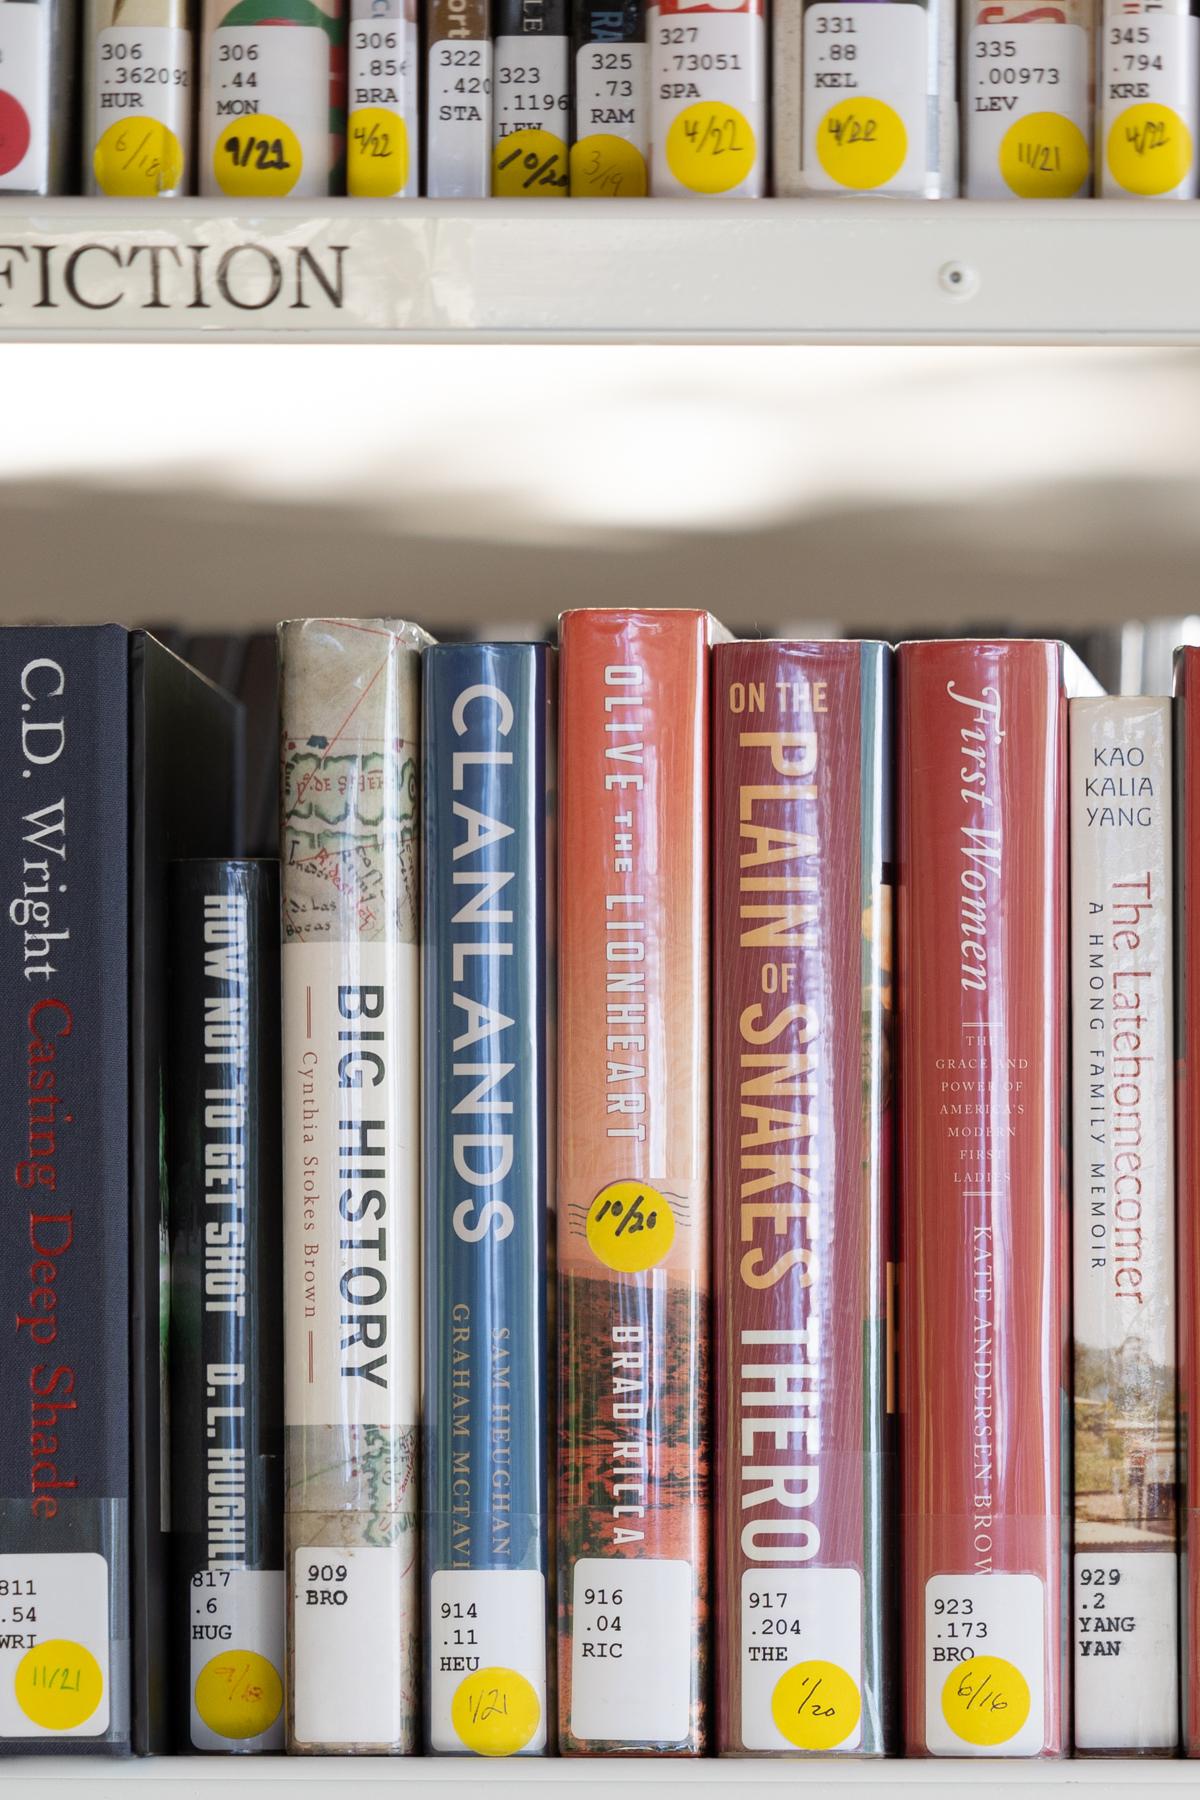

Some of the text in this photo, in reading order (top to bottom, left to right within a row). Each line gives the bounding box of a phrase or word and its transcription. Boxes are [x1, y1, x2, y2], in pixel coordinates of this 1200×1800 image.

[816, 17, 856, 33] 331
[660, 27, 698, 45] 327
[100, 43, 141, 61] 306
[219, 44, 258, 61] 306
[819, 44, 856, 61] .88
[976, 41, 1016, 58] 335
[662, 54, 741, 73] .73051
[222, 72, 257, 88] .44
[815, 73, 857, 88] KEL
[979, 68, 1060, 85] .00973
[660, 83, 700, 99] SPA
[99, 93, 143, 108] HUR
[217, 100, 259, 115] MON
[975, 96, 1018, 112] LEV
[684, 118, 743, 156] 4/22
[1018, 142, 1061, 172] 11/21
[729, 681, 828, 713] ON THE
[1094, 747, 1144, 766] KAO
[1085, 777, 1153, 796] KALIA
[9, 657, 70, 982] C.D. Wright
[1087, 808, 1152, 826] YANG
[740, 732, 819, 948] PLAIN
[947, 680, 1001, 991] First Women
[604, 664, 646, 1142] OLIVE THE LIONHEART
[451, 684, 514, 1242] CLANLANDS
[761, 963, 794, 994] OF
[1111, 872, 1153, 1304] The Latehomecomer
[740, 1003, 821, 1290] SNAKES
[301, 1052, 320, 1319] Cynthia Stokes Brown
[338, 985, 388, 1390] BIG HISTORY
[15, 998, 78, 1521] Casting Deep Shade
[613, 1326, 644, 1545] BRAD RICCA
[308, 1565, 347, 1581] 909
[306, 1590, 348, 1605] BRO
[585, 1589, 622, 1605] 916
[750, 1593, 787, 1608] 917
[441, 1603, 477, 1618] 914
[935, 1599, 973, 1615] 923
[587, 1616, 621, 1631] .04
[752, 1619, 800, 1635] .204
[937, 1622, 987, 1638] .173
[444, 1629, 477, 1645] .11
[582, 1643, 622, 1658] RIC
[749, 1647, 787, 1661] THE
[933, 1647, 974, 1661] BRO
[440, 1657, 479, 1671] HEU
[958, 1673, 1007, 1712] 6/16
[467, 1689, 509, 1722] 1/21
